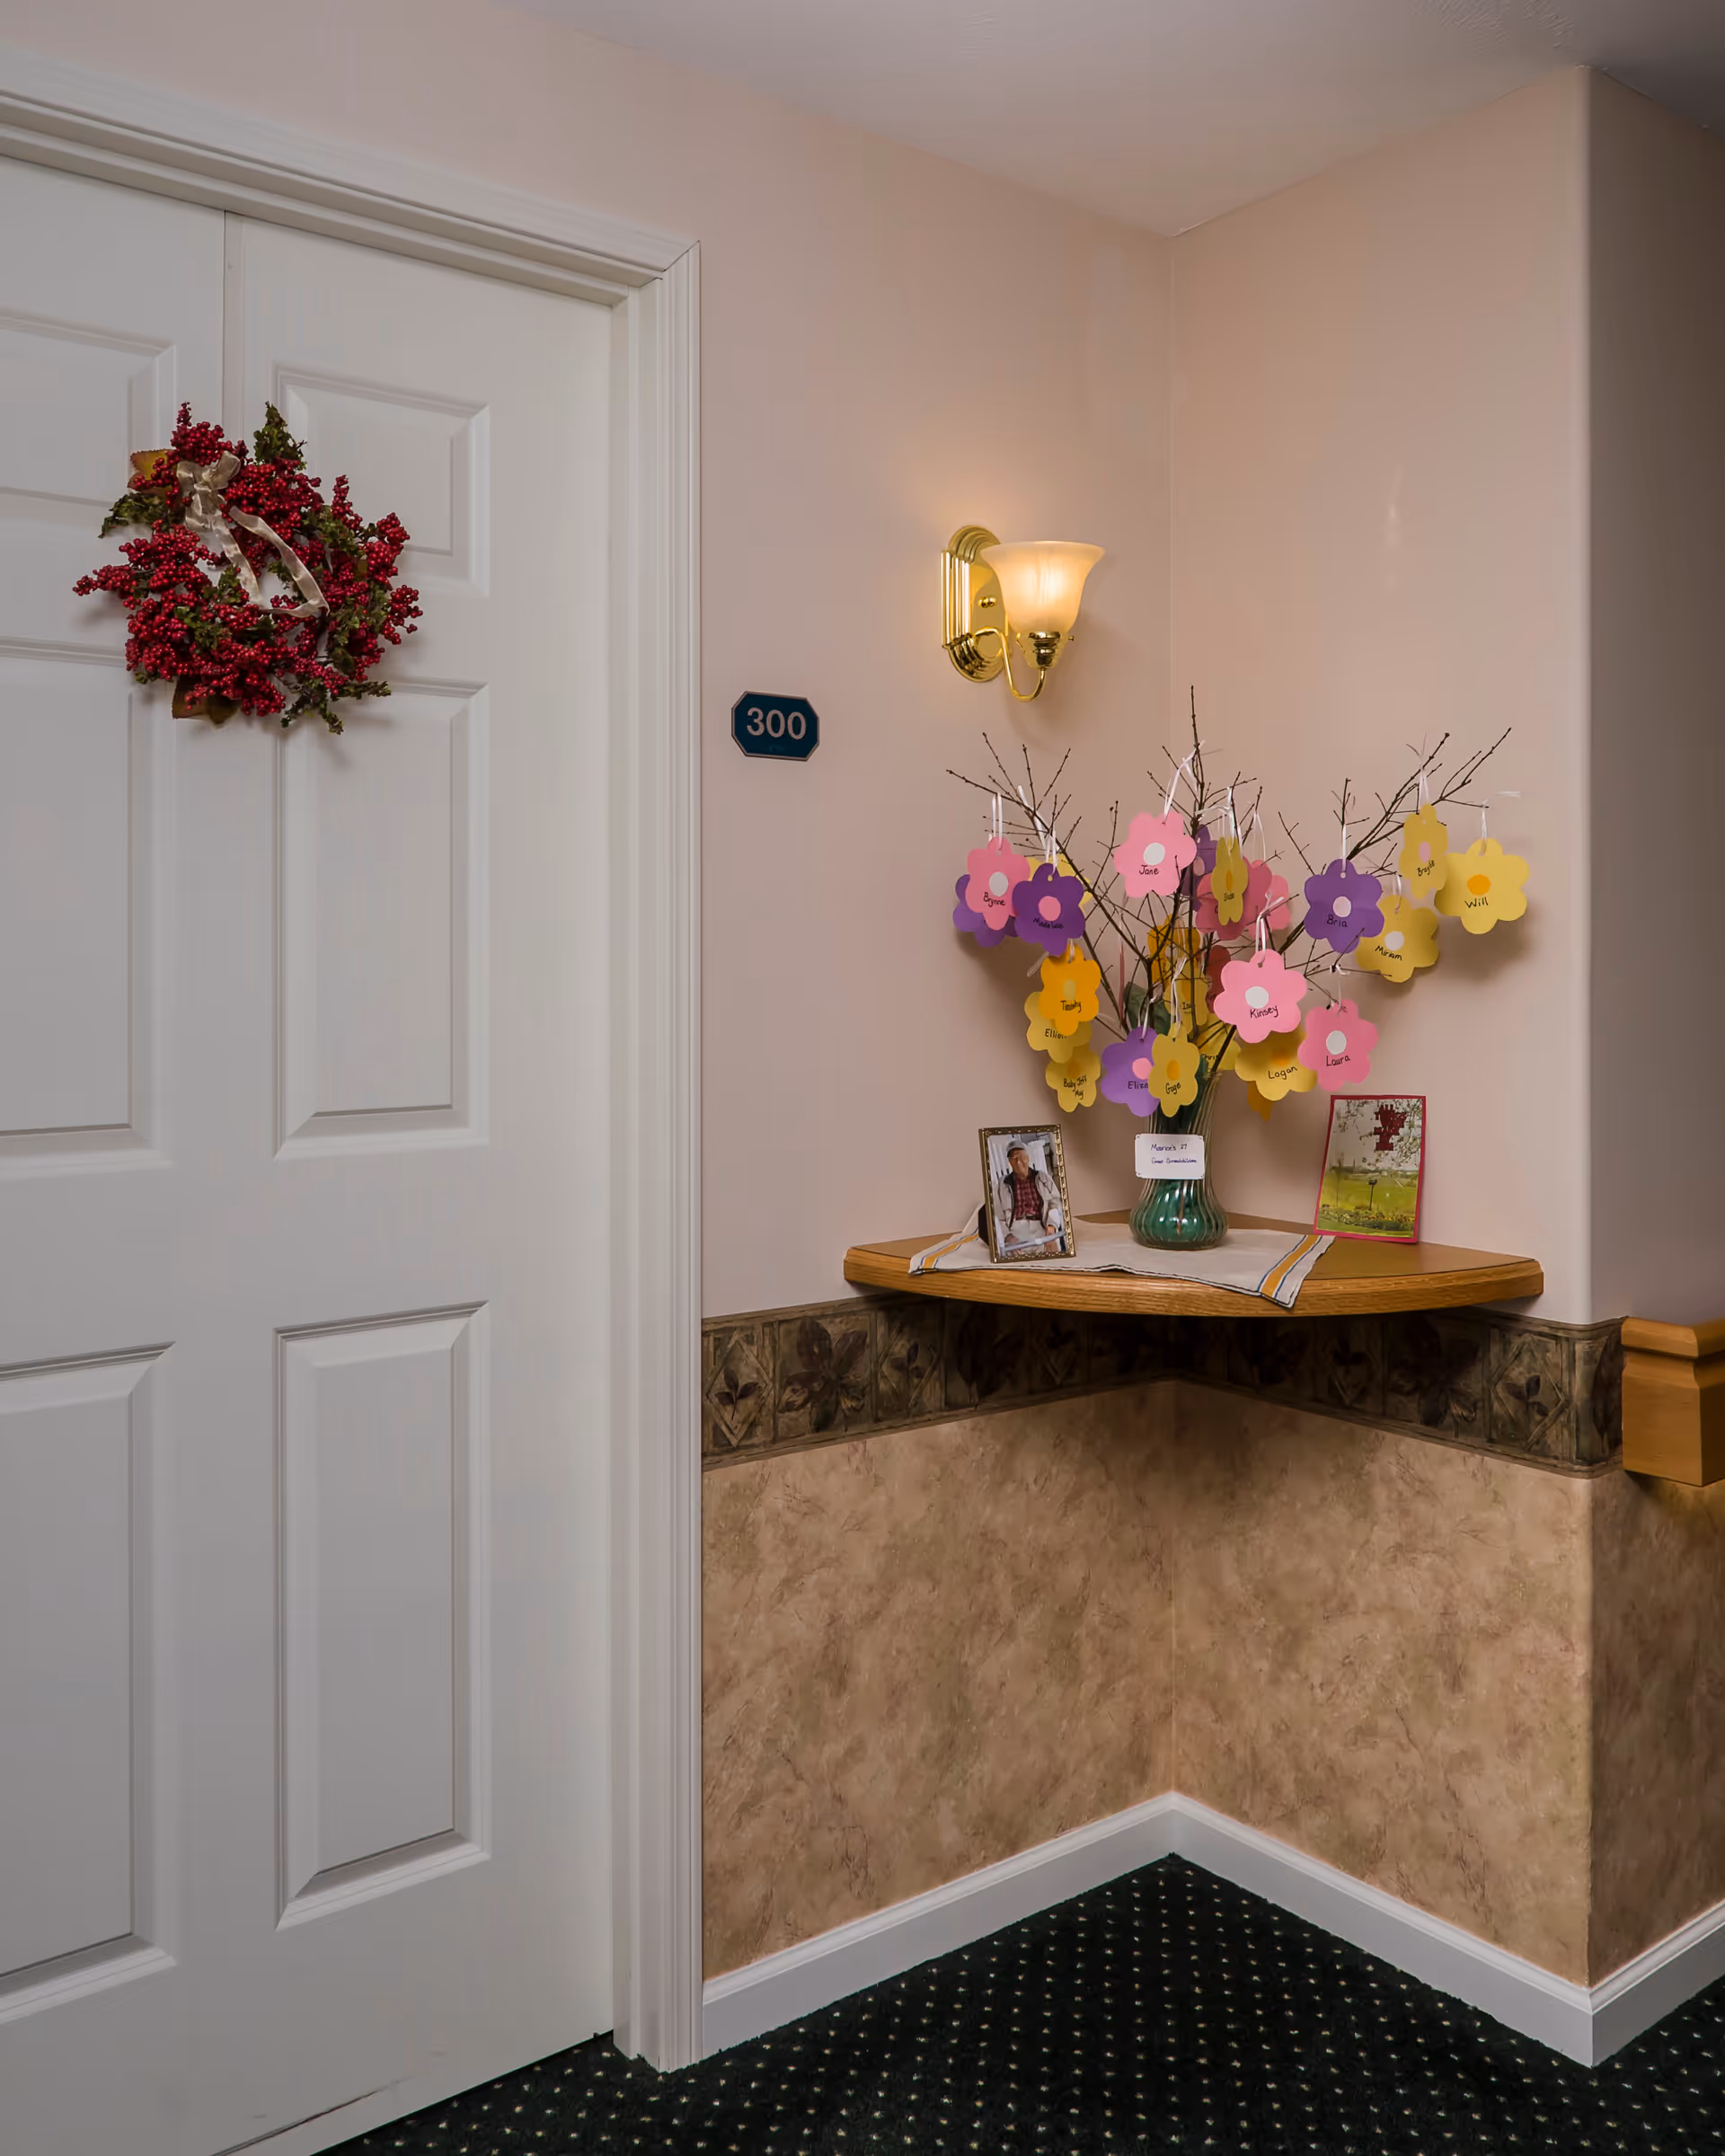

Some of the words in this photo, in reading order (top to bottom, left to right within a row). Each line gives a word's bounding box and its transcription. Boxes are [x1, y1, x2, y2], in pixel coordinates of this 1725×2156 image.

[746, 706, 807, 740] 300
[1138, 864, 1160, 875] Jane
[1464, 896, 1489, 909] Will
[1326, 914, 1348, 928] Bria
[1375, 945, 1402, 961] Miriam
[1250, 1005, 1279, 1019] Kinsey
[1325, 1055, 1351, 1067] Laura
[1268, 1065, 1298, 1081] Logan
[1164, 1082, 1181, 1095] Gage
